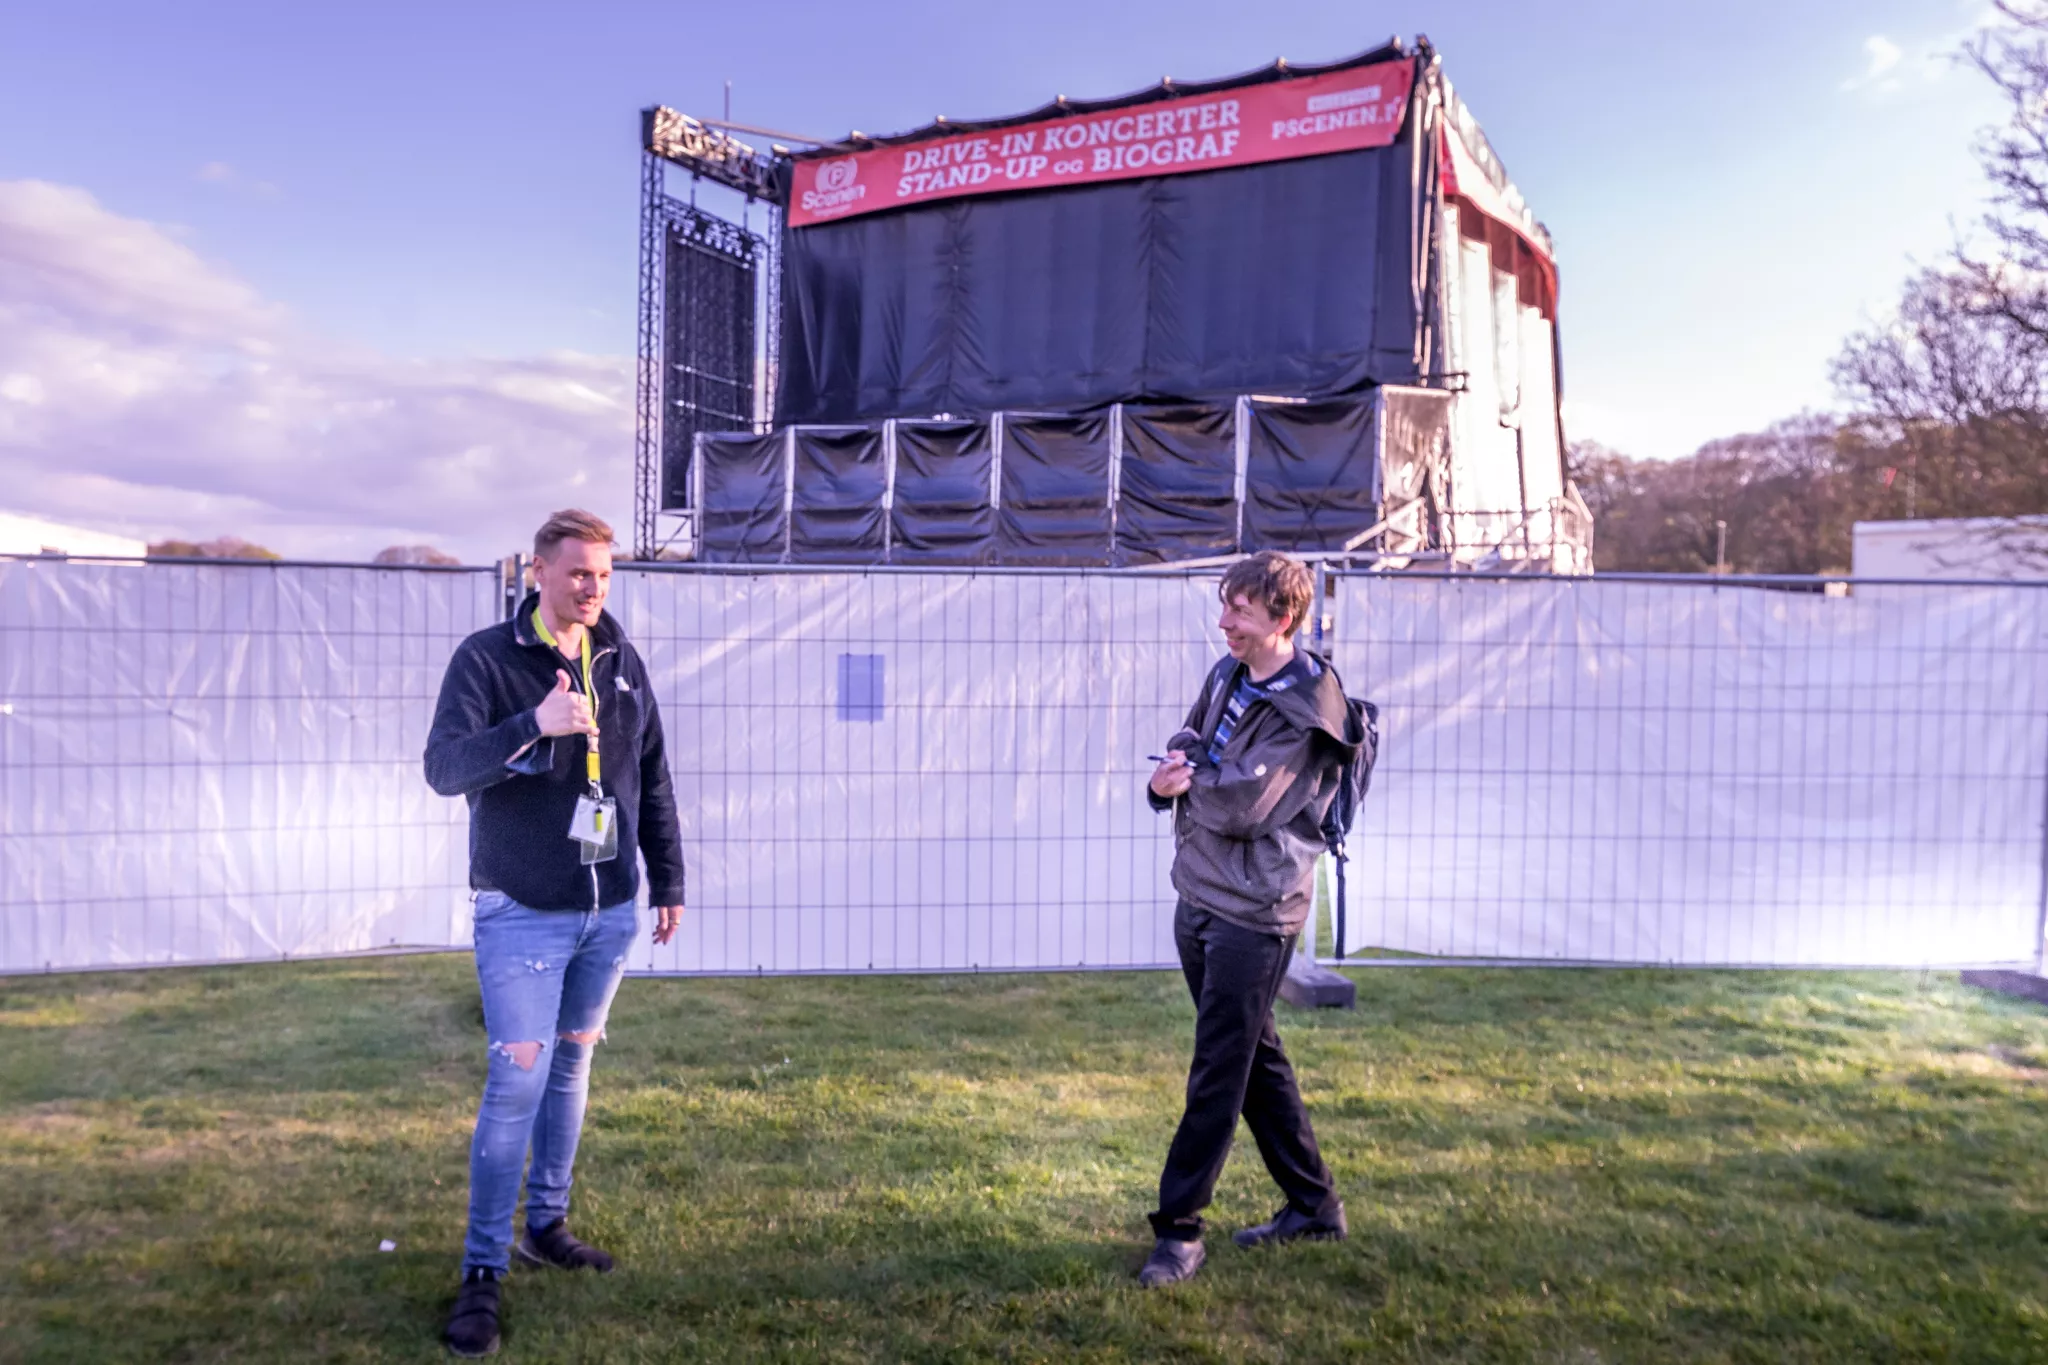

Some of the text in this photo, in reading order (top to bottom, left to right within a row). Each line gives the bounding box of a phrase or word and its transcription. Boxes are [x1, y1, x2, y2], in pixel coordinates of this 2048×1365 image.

[896, 155, 1048, 197] STAND-UP
[1091, 129, 1241, 173] BIOGRAF
[902, 99, 1241, 174] DRIVE-IN KONCERTER
